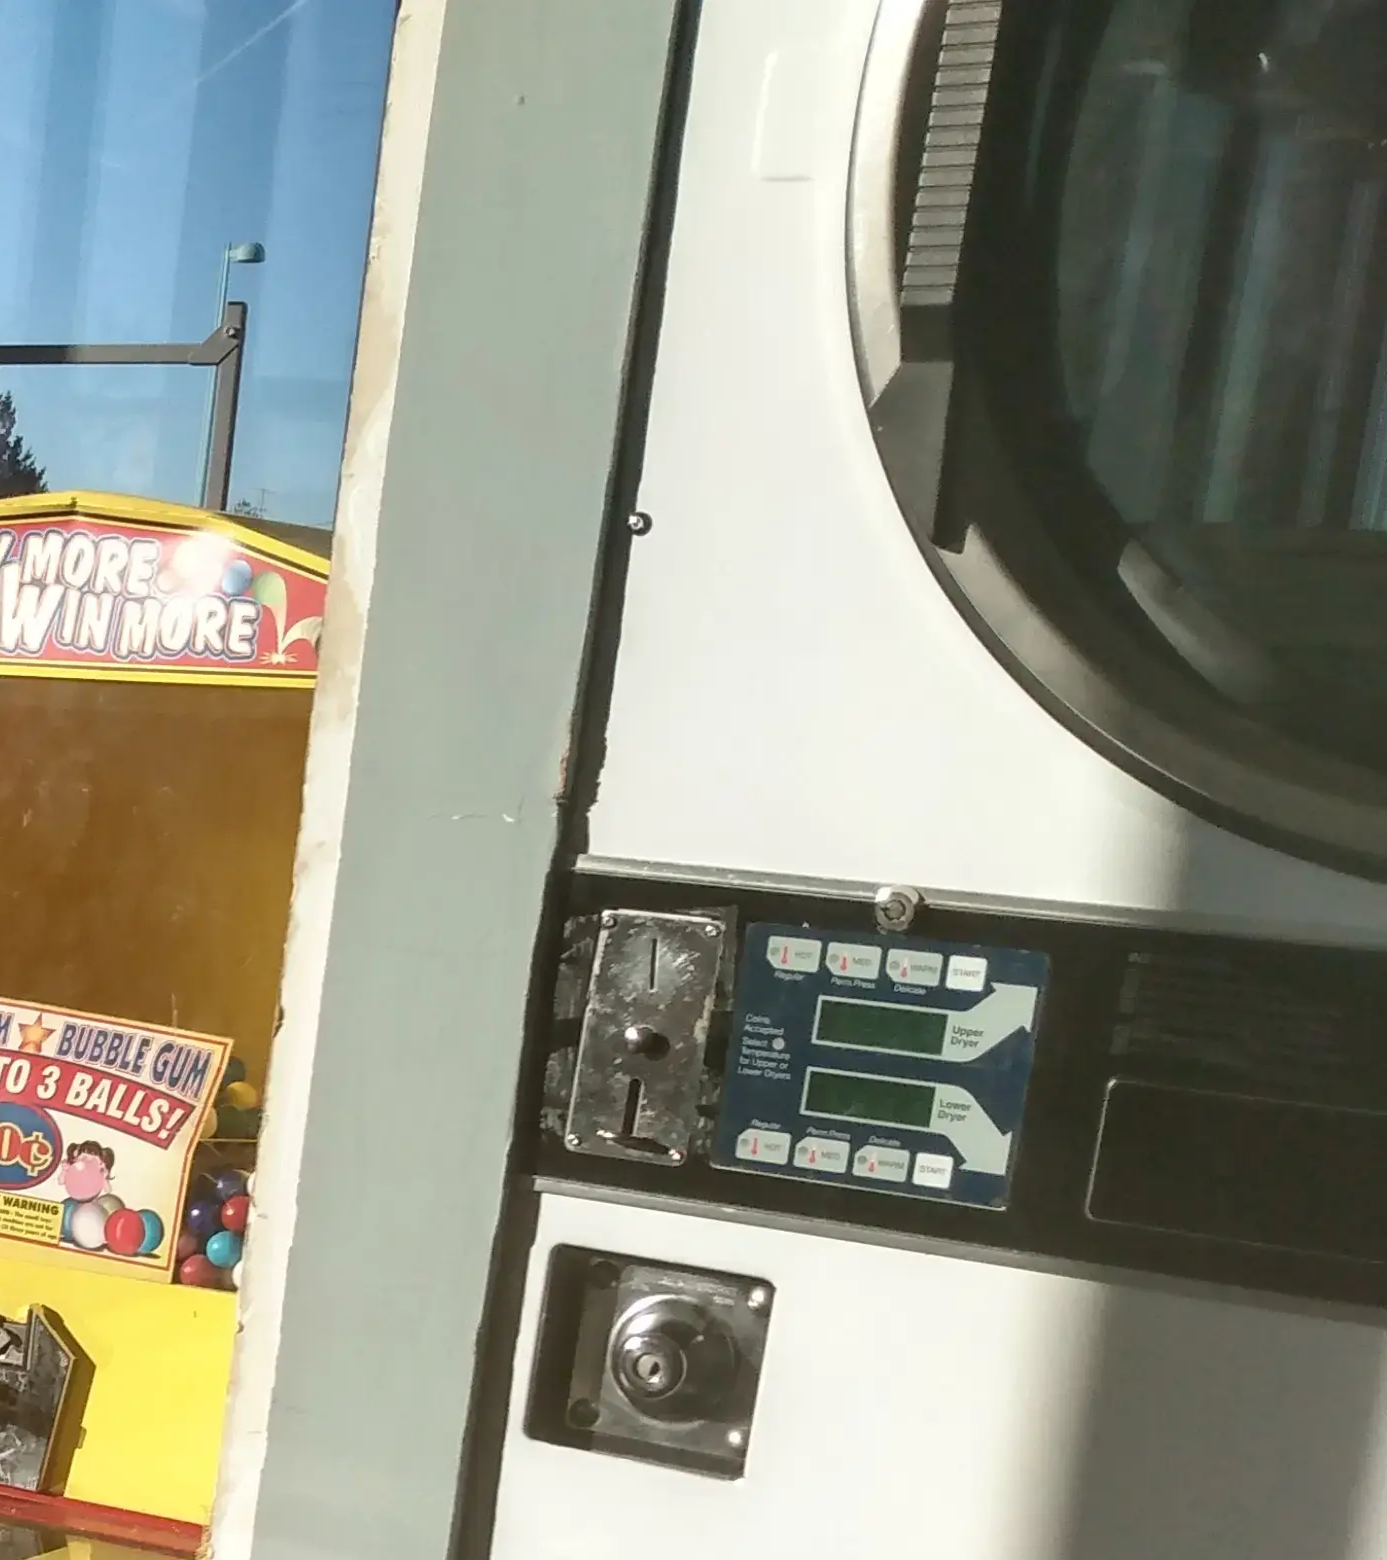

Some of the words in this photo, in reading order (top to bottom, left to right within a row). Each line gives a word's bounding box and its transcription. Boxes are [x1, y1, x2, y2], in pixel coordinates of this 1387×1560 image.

[20, 529, 159, 598] MORE
[113, 595, 260, 662] MORE
[952, 967, 981, 978] START
[952, 1025, 985, 1037] Upper
[950, 1036, 979, 1048] Dryer
[55, 1022, 153, 1075] BUBBLE
[151, 1040, 213, 1100] GUM
[36, 1065, 60, 1100] 3
[65, 1071, 185, 1140] BALLS!
[939, 1099, 971, 1111] Lower
[937, 1110, 966, 1122] Dryer
[919, 1165, 947, 1176] START
[3, 1196, 59, 1215] WARNING
